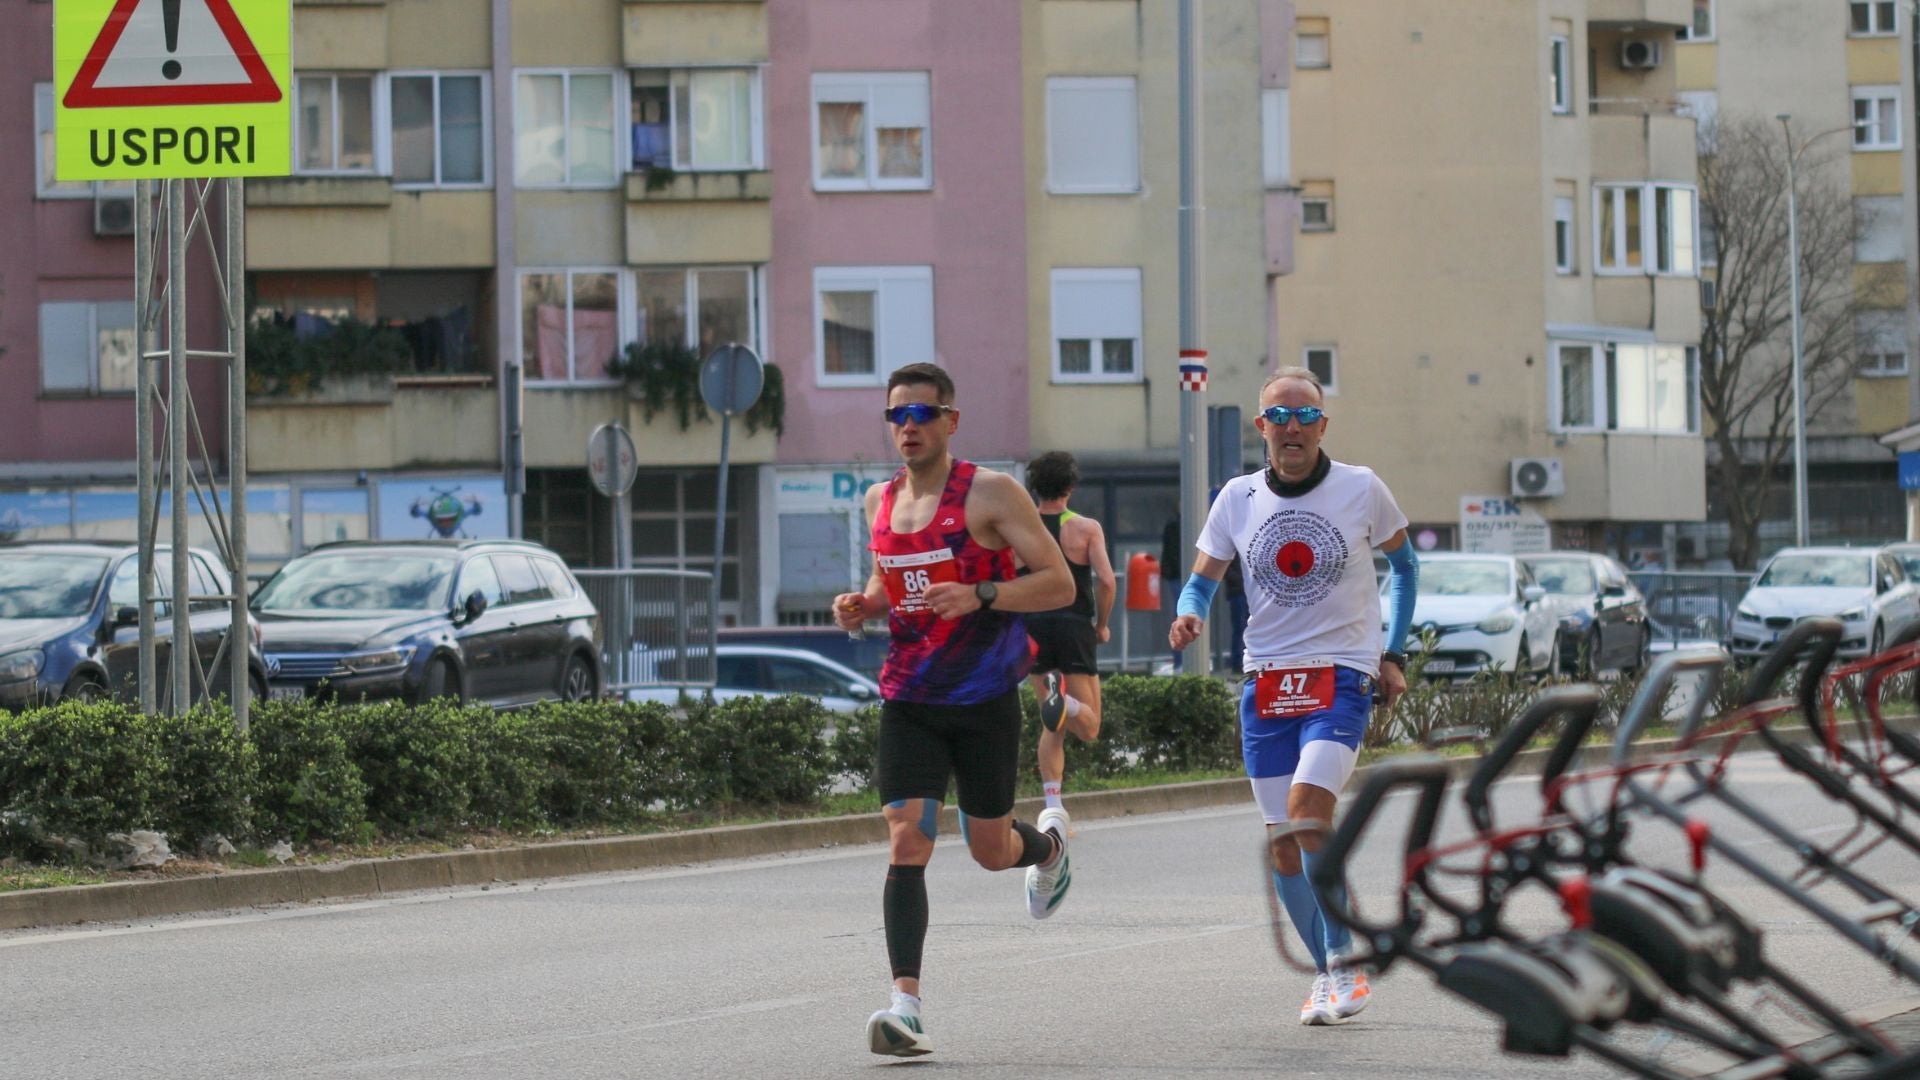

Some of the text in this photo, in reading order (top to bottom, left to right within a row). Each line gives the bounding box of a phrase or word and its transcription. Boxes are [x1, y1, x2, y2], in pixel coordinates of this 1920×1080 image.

[90, 126, 257, 167] USPORI
[1247, 531, 1259, 568] SARAJEVO
[1259, 509, 1295, 532] MARATHON
[1333, 526, 1348, 559] CEDEVITA
[1329, 535, 1341, 553] MOST
[903, 569, 931, 592] 86
[1279, 673, 1308, 694] 47
